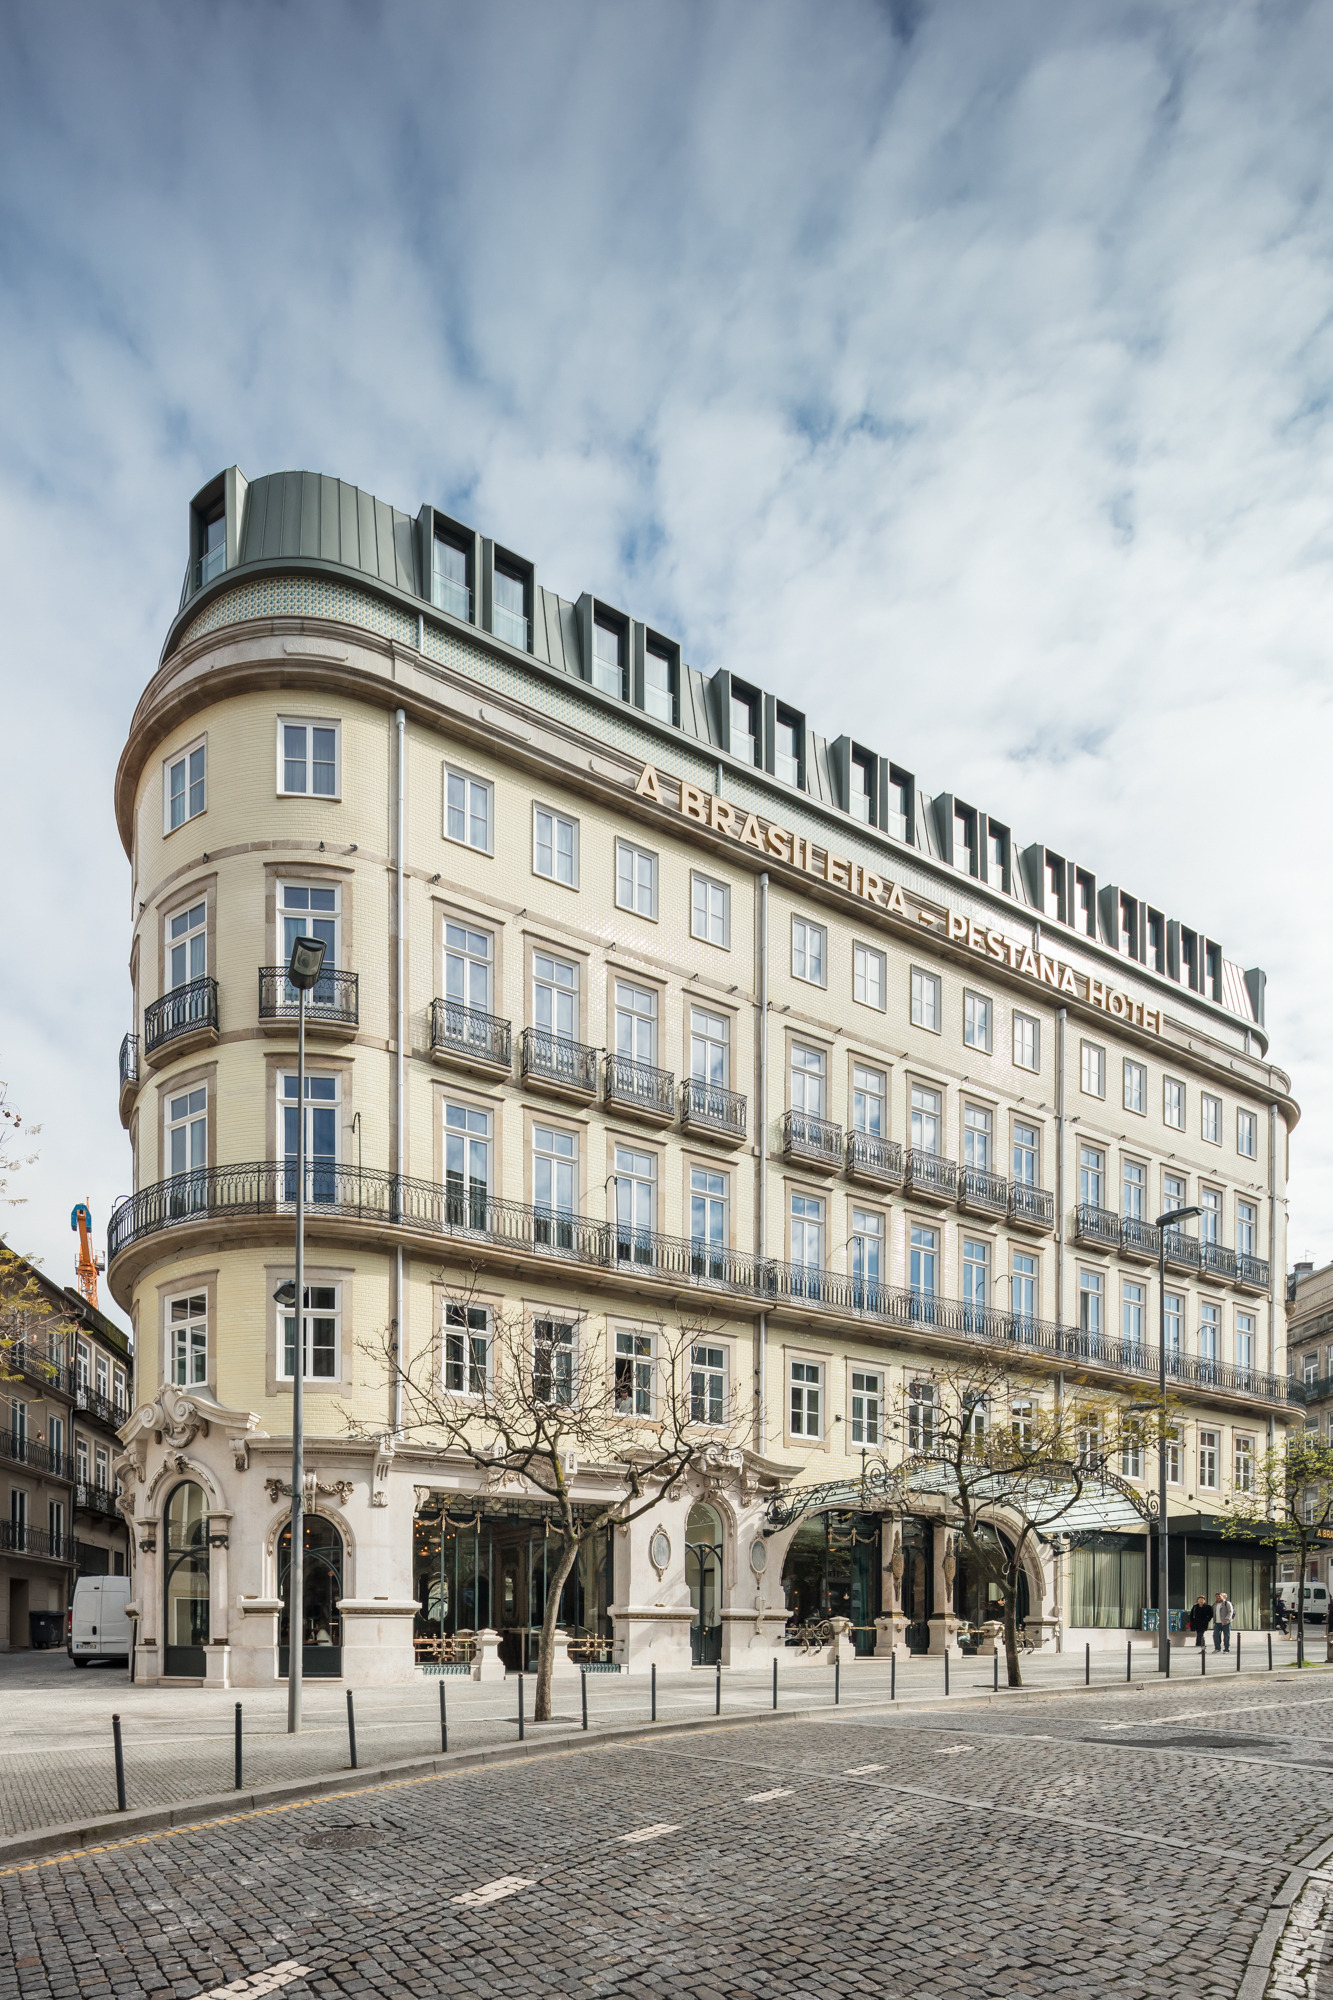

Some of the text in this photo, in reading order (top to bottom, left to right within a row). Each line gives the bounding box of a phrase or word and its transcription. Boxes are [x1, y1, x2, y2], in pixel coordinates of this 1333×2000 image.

[635, 763, 664, 805] A
[679, 780, 908, 917] BRASILEIRA
[946, 908, 1079, 998] PESTANA
